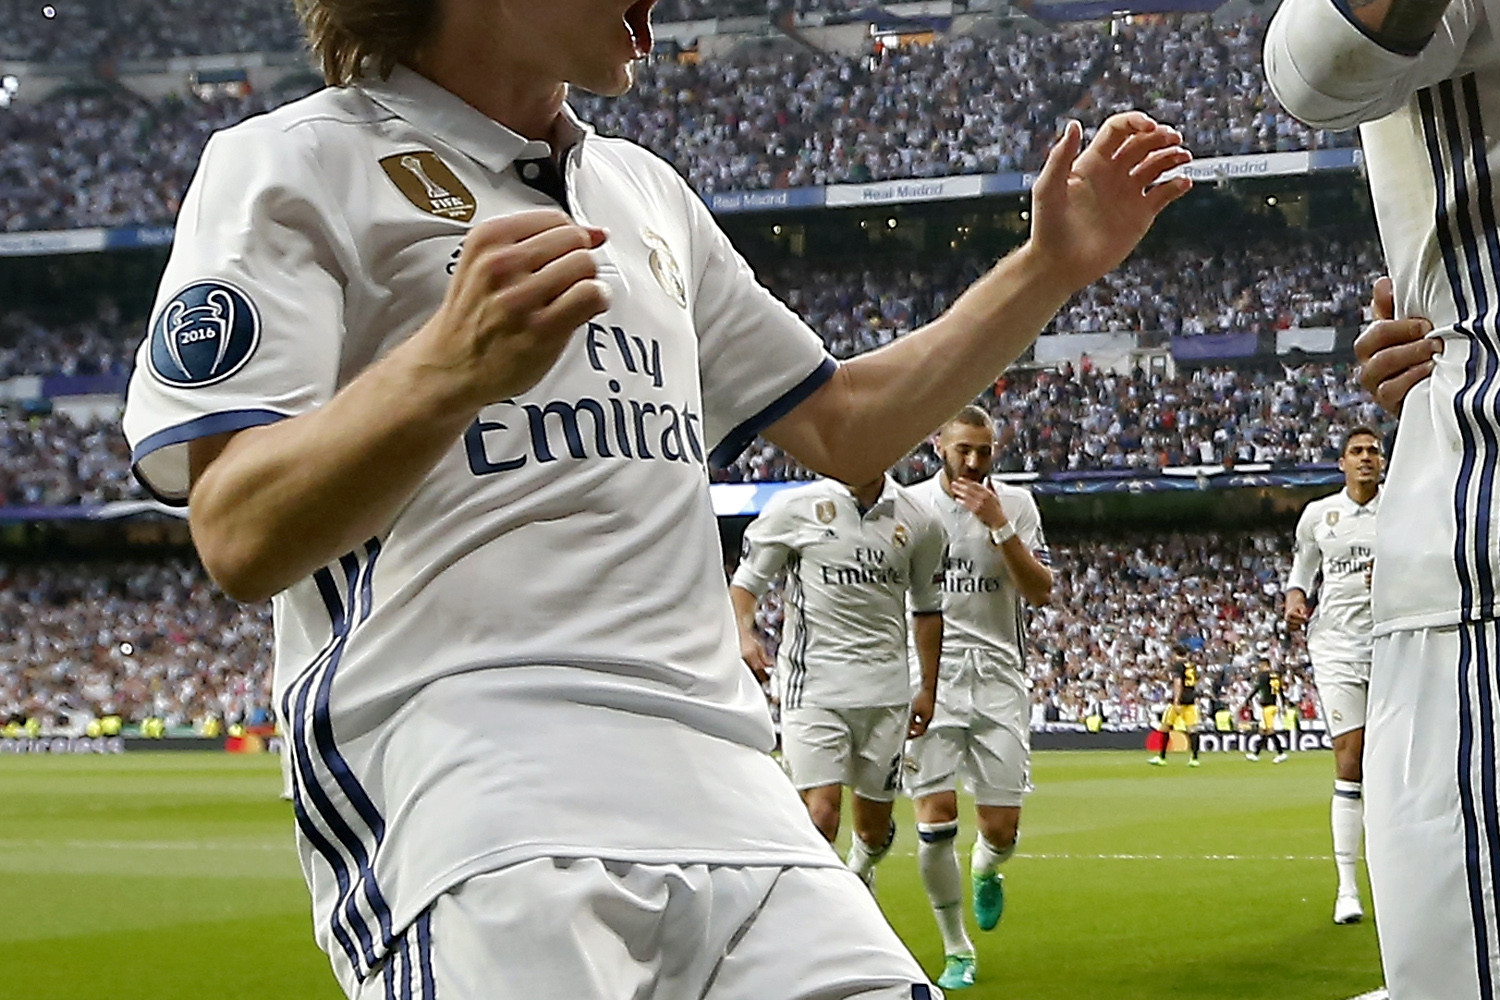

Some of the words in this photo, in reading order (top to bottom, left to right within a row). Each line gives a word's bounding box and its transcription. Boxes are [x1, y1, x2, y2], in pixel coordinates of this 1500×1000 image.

[1183, 165, 1215, 177] Real
[1218, 160, 1269, 174] Madrid
[713, 194, 740, 208] Real
[743, 191, 787, 206] Madrid
[863, 187, 893, 200] Real
[896, 184, 944, 198] Madrid
[430, 197, 464, 210] FIFA
[181, 327, 216, 344] 2016
[586, 322, 663, 388] Fly
[855, 547, 884, 564] Fly
